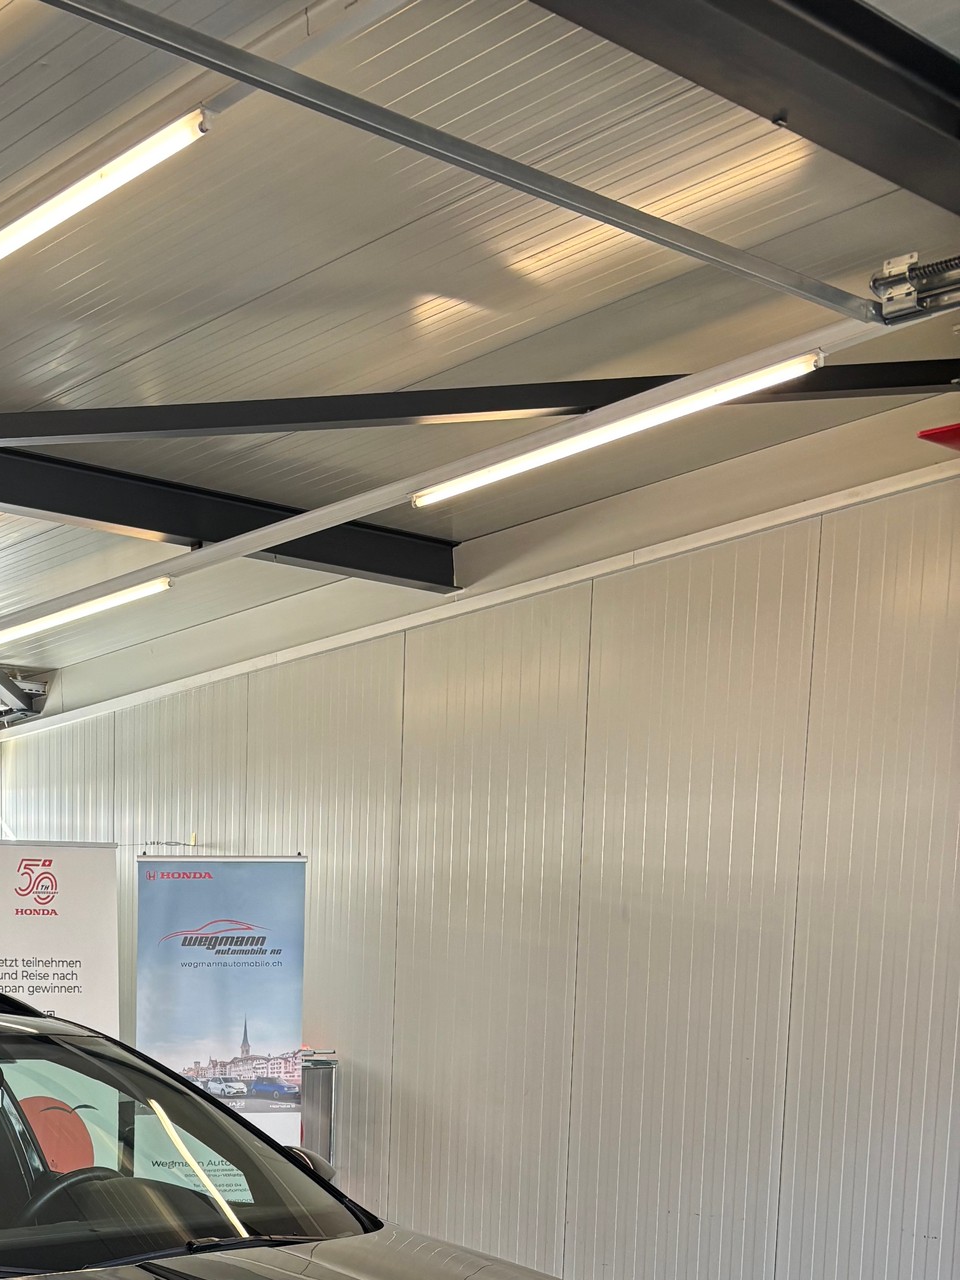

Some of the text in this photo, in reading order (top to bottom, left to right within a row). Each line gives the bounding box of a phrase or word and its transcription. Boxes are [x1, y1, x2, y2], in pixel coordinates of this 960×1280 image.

[15, 908, 59, 916] HONDA
[181, 935, 267, 951] wegmann
[21, 956, 82, 968] teilnehmen
[180, 960, 283, 969] wegmannautomobile.ch
[21, 970, 50, 981] Reise
[52, 970, 78, 981] nach
[27, 982, 82, 996] gewinnen:
[151, 1160, 204, 1169] Wegman
